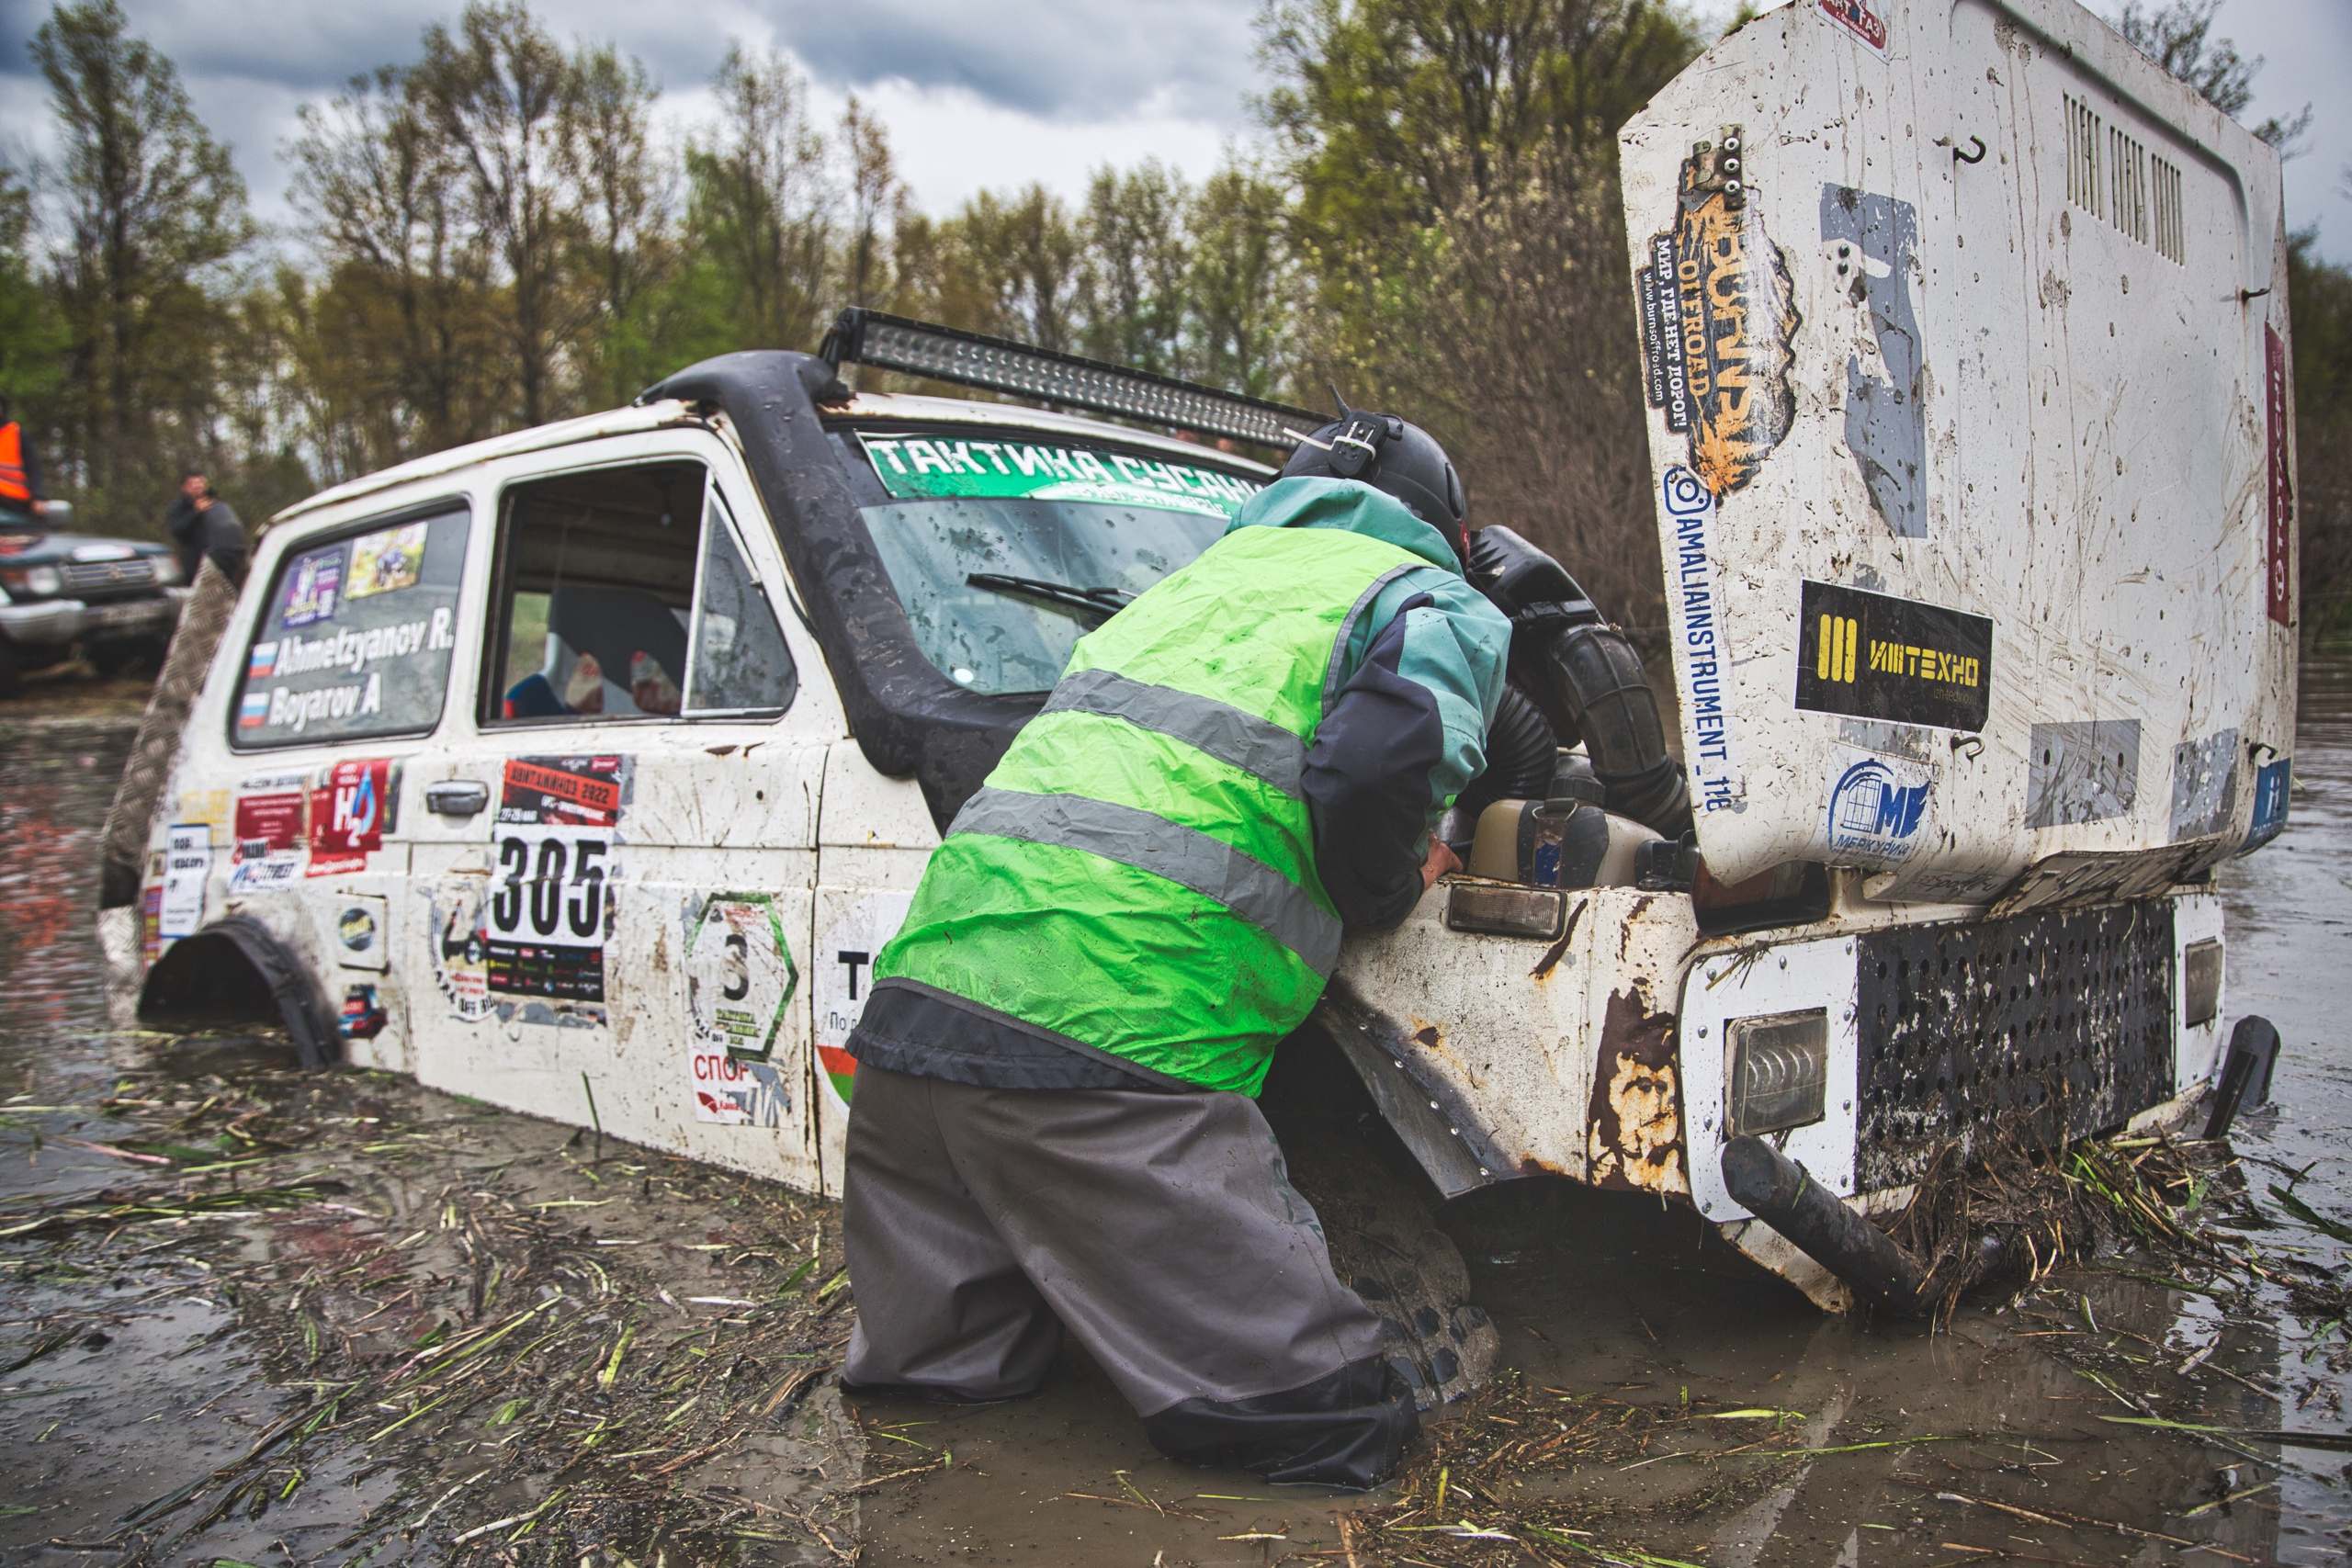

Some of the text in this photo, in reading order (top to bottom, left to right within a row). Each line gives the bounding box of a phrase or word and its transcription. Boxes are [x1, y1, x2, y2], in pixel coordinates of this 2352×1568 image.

[1656, 239, 1676, 287] МИР,
[1669, 363, 1689, 428] ДОРОГ!
[867, 439, 1267, 504] ТАКТИКА СУСАНИ
[272, 605, 455, 679] Ahmetzyanov R.
[267, 671, 382, 733] Boyarov A
[581, 783, 611, 805] 2022
[493, 837, 607, 939] 305
[723, 933, 749, 1001] 3
